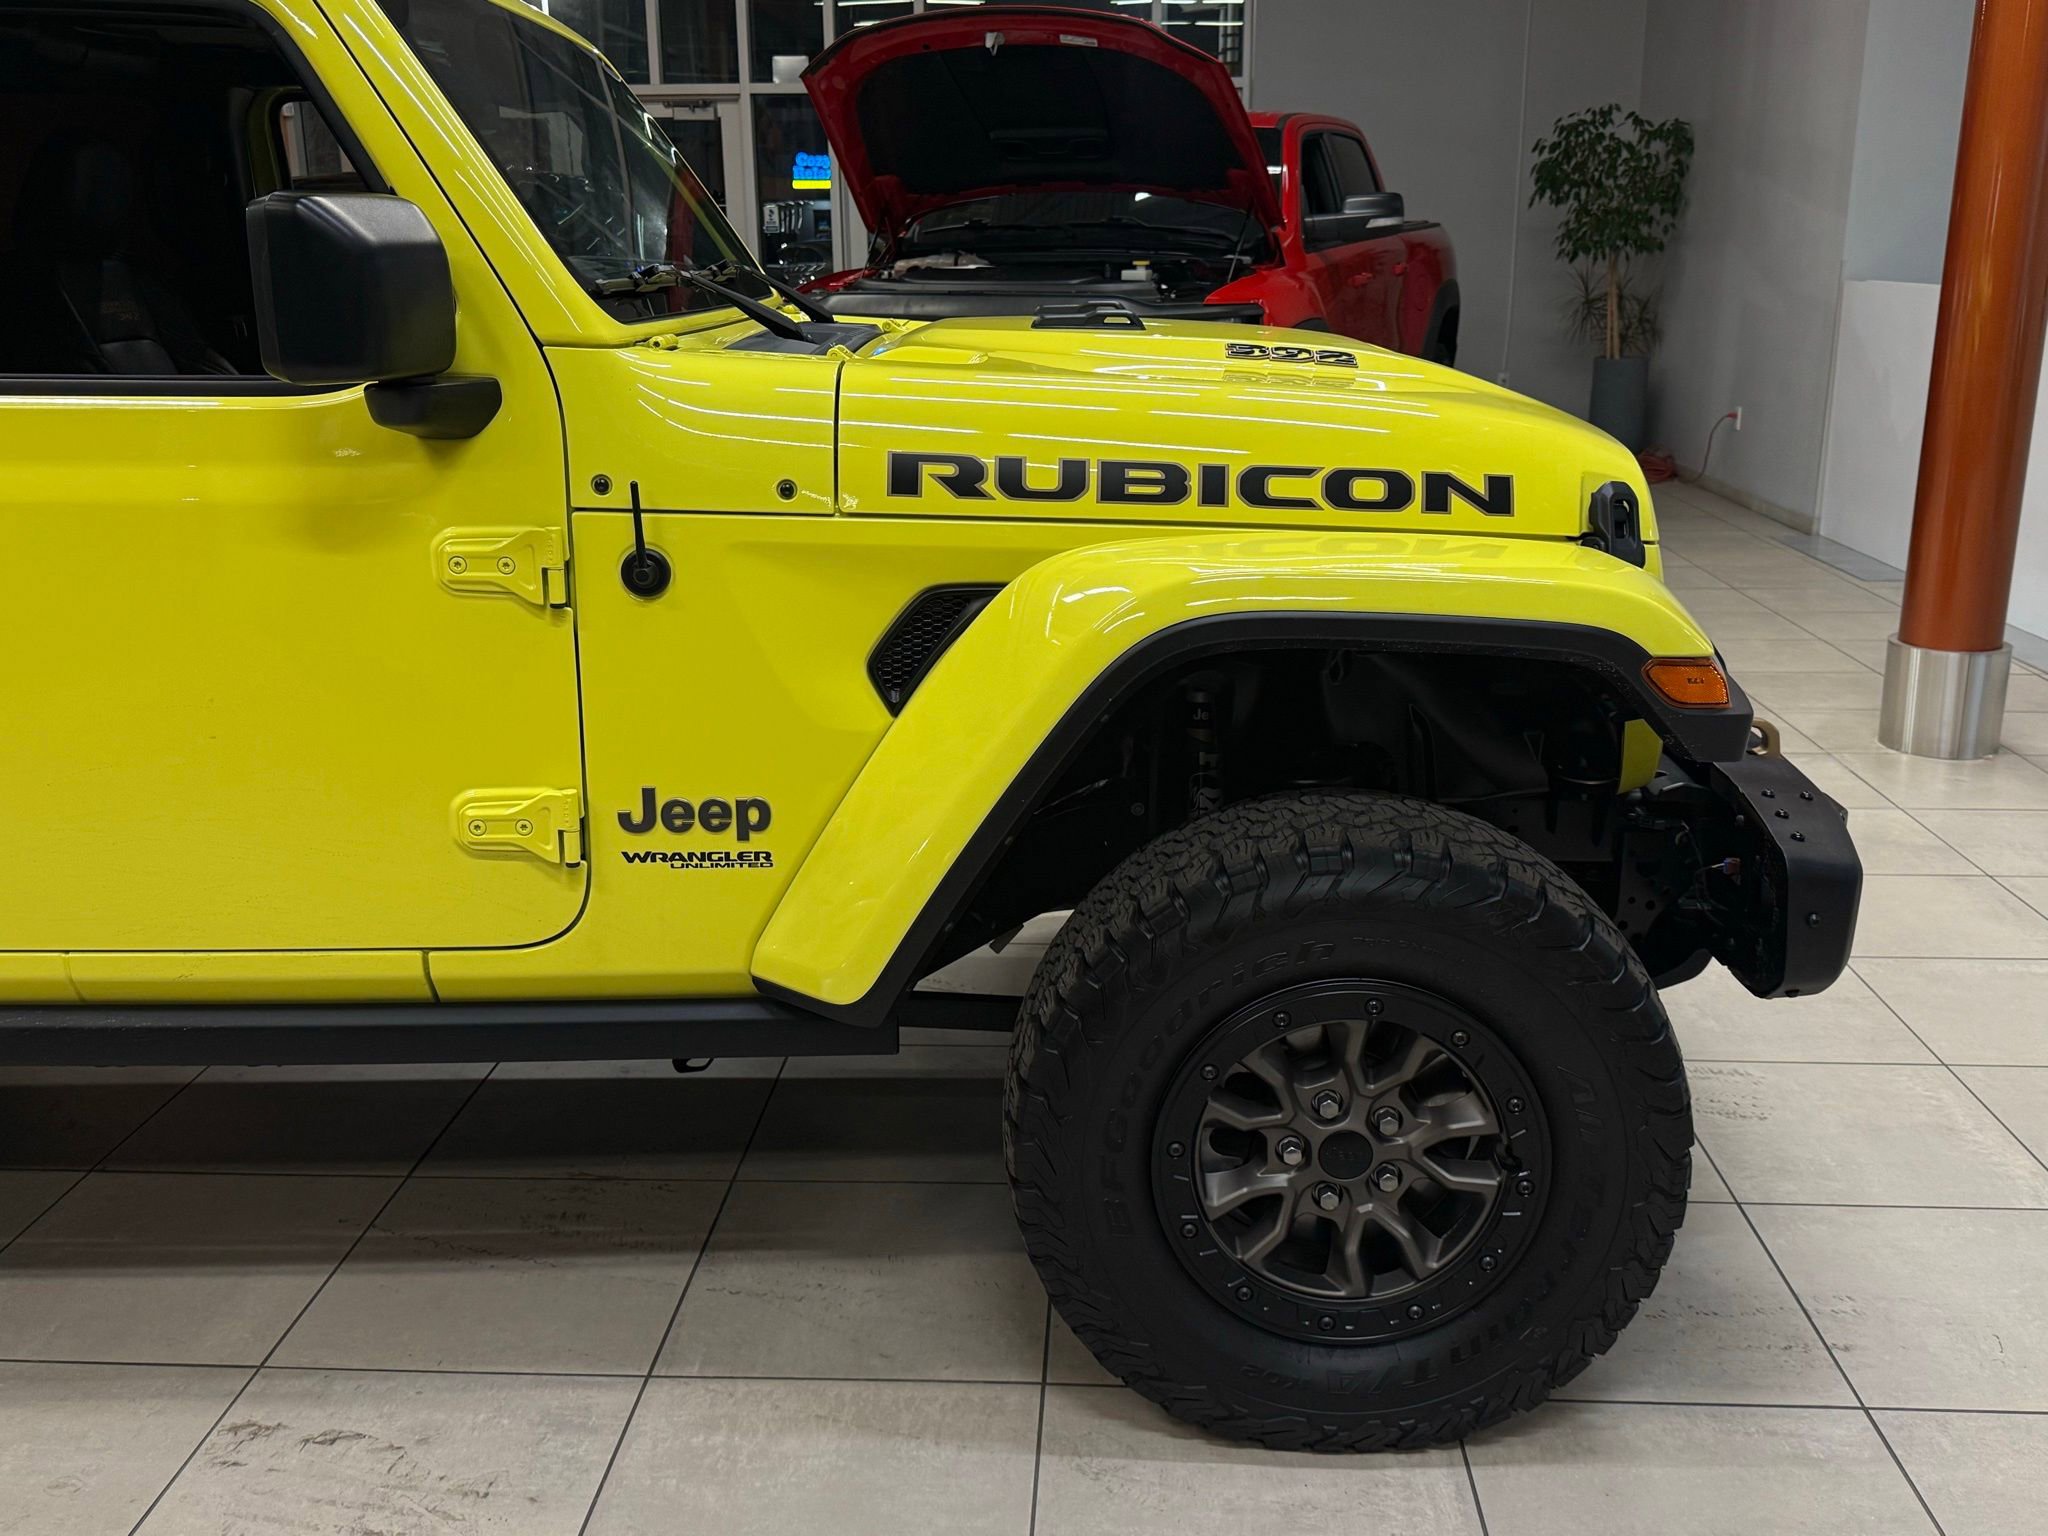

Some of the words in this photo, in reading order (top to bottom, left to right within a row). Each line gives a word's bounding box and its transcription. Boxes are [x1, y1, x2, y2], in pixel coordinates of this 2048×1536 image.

[1225, 343, 1359, 368] 392
[886, 450, 1515, 517] RUBICON
[617, 785, 772, 842] Jeep
[621, 851, 773, 864] WRANGLER
